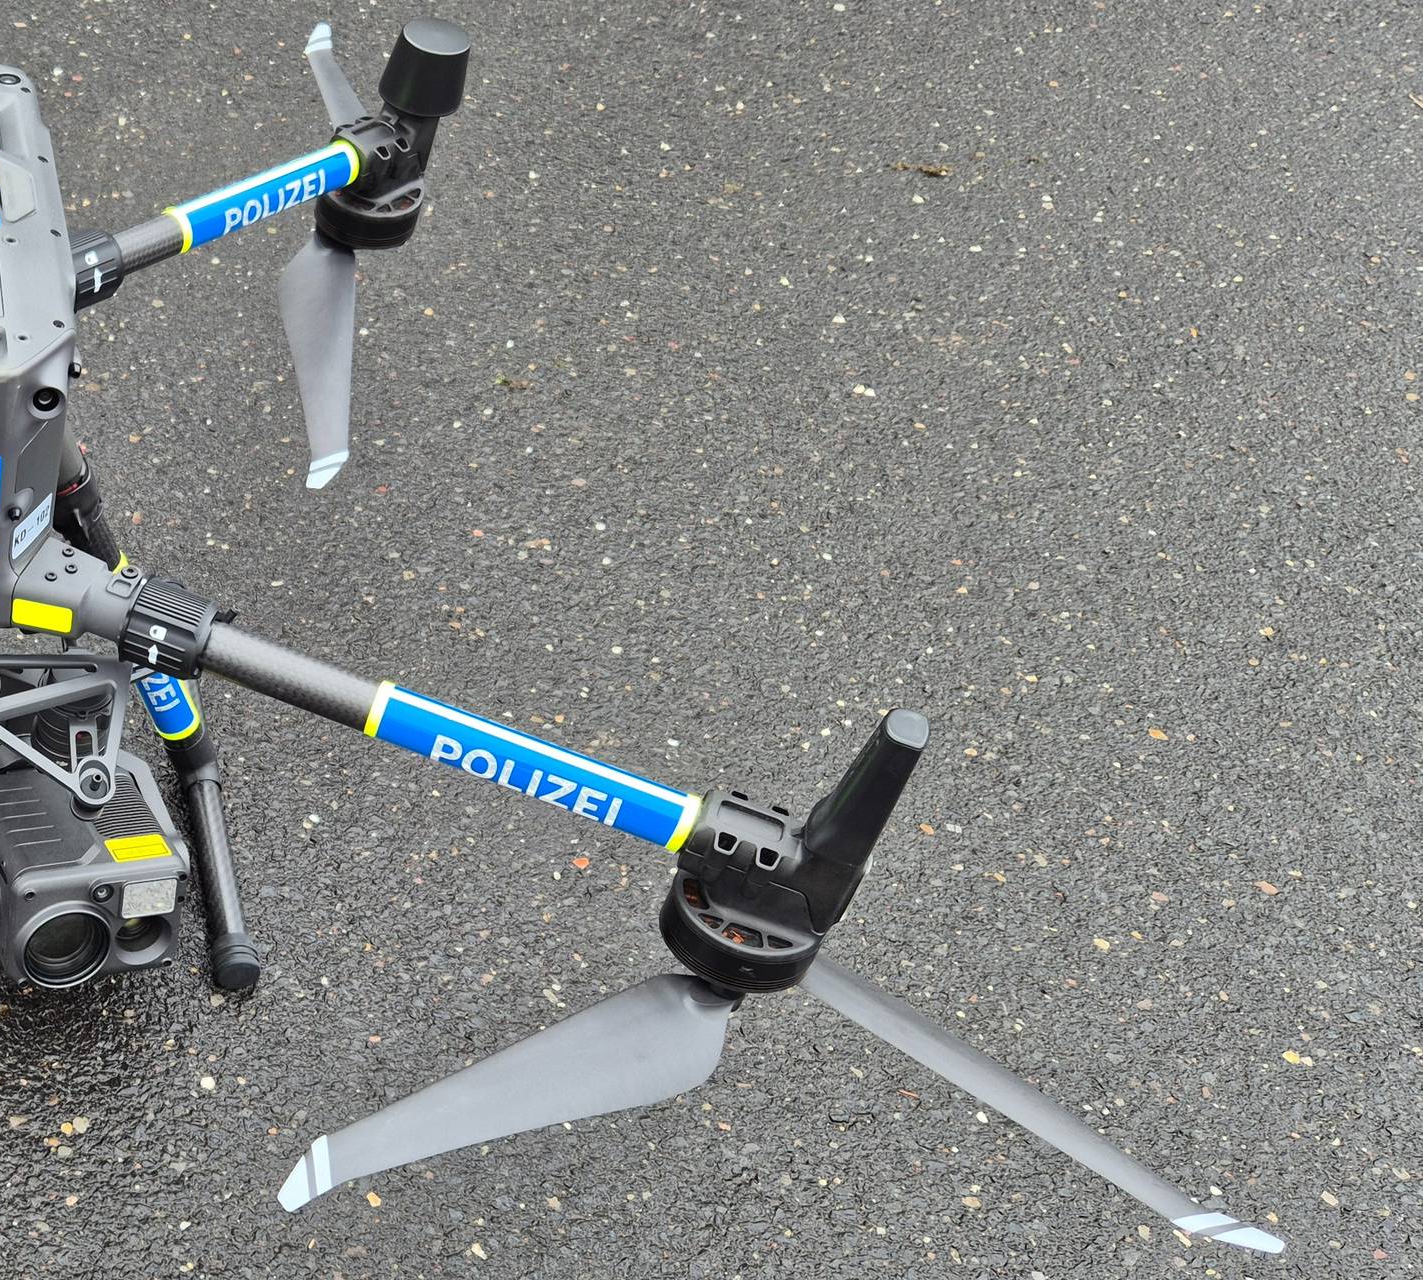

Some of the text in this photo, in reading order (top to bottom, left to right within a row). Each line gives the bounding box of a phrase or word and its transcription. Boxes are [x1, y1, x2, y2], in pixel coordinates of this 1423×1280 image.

[223, 168, 326, 236] POLIZEI
[14, 529, 26, 548] KD
[429, 734, 623, 827] POLIZEI
